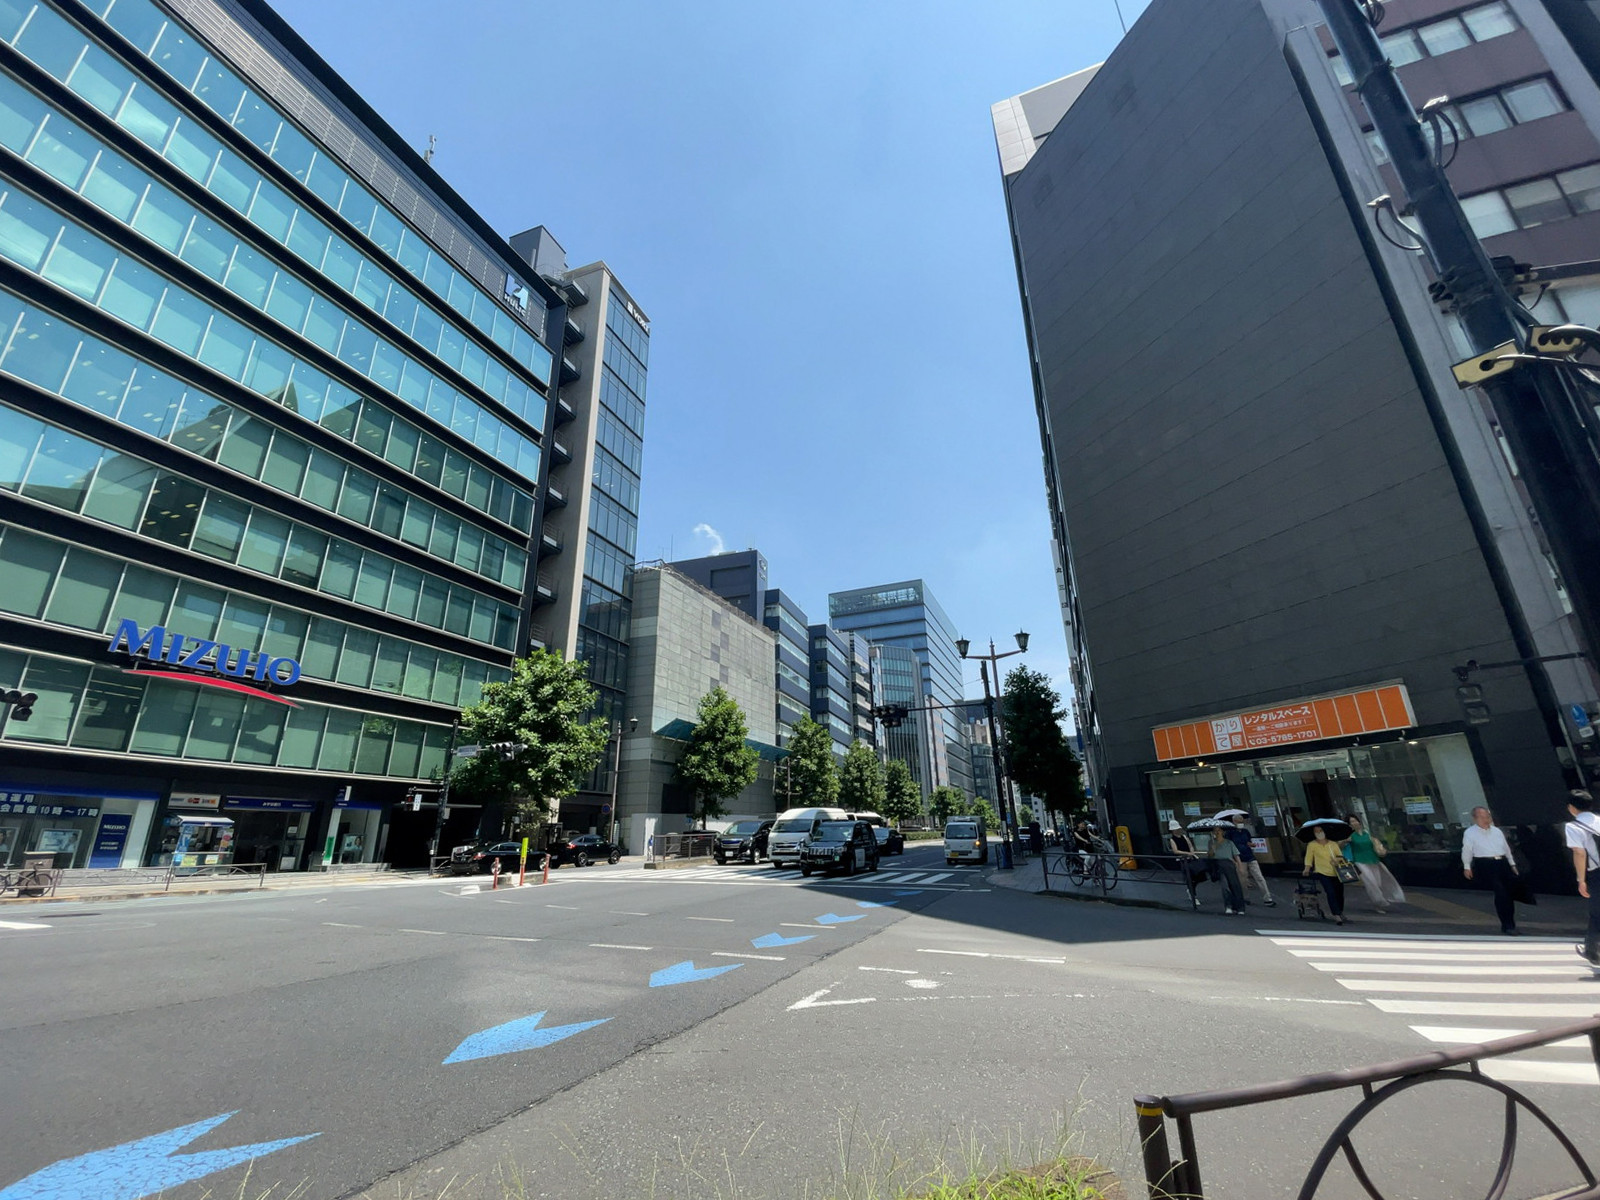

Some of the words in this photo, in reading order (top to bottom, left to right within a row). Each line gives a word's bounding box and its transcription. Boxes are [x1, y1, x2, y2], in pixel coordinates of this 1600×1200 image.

[108, 618, 302, 686] MIZUHO
[1243, 705, 1311, 725] レンタルスペース
